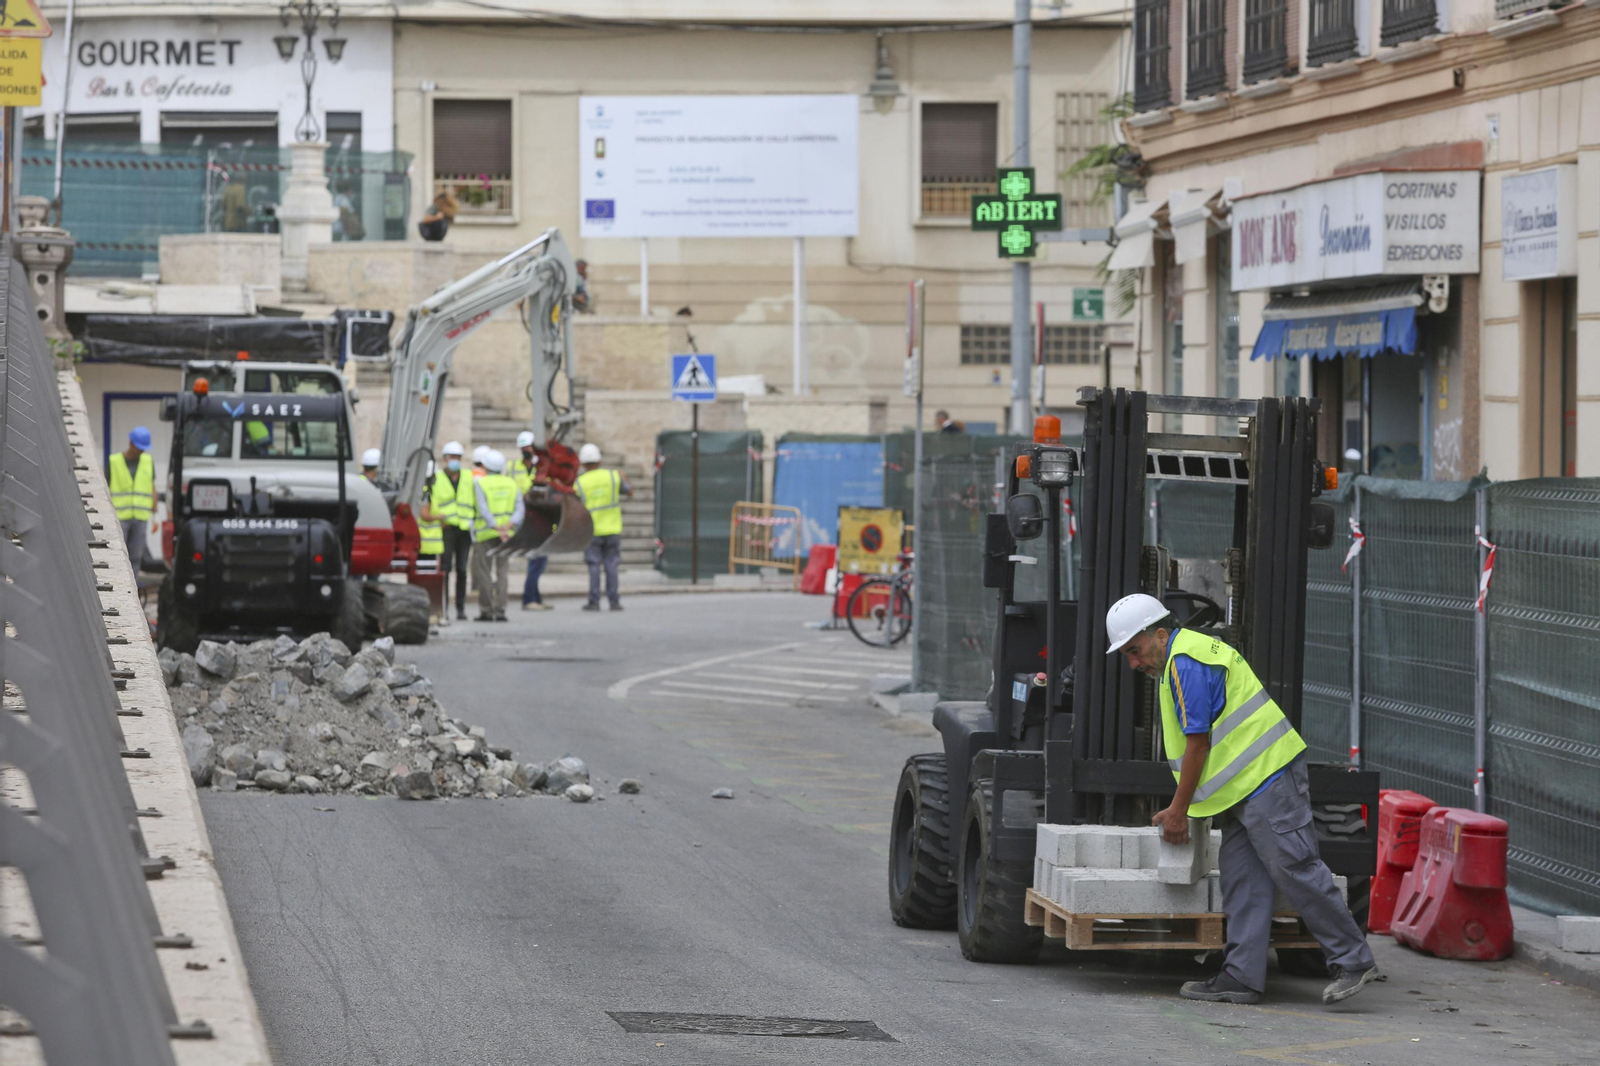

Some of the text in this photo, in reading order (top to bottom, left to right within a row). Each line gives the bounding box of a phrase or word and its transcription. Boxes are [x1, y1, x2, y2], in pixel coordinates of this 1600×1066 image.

[0, 49, 28, 60] LIDA
[78, 40, 241, 67] GOURMET
[1386, 182, 1457, 199] CORTINAS
[976, 200, 1058, 222] ABIERT
[1385, 213, 1447, 231] VISILLOS
[1386, 244, 1463, 261] EDREDONES
[251, 403, 303, 417] SAEZ
[222, 518, 246, 530] 655
